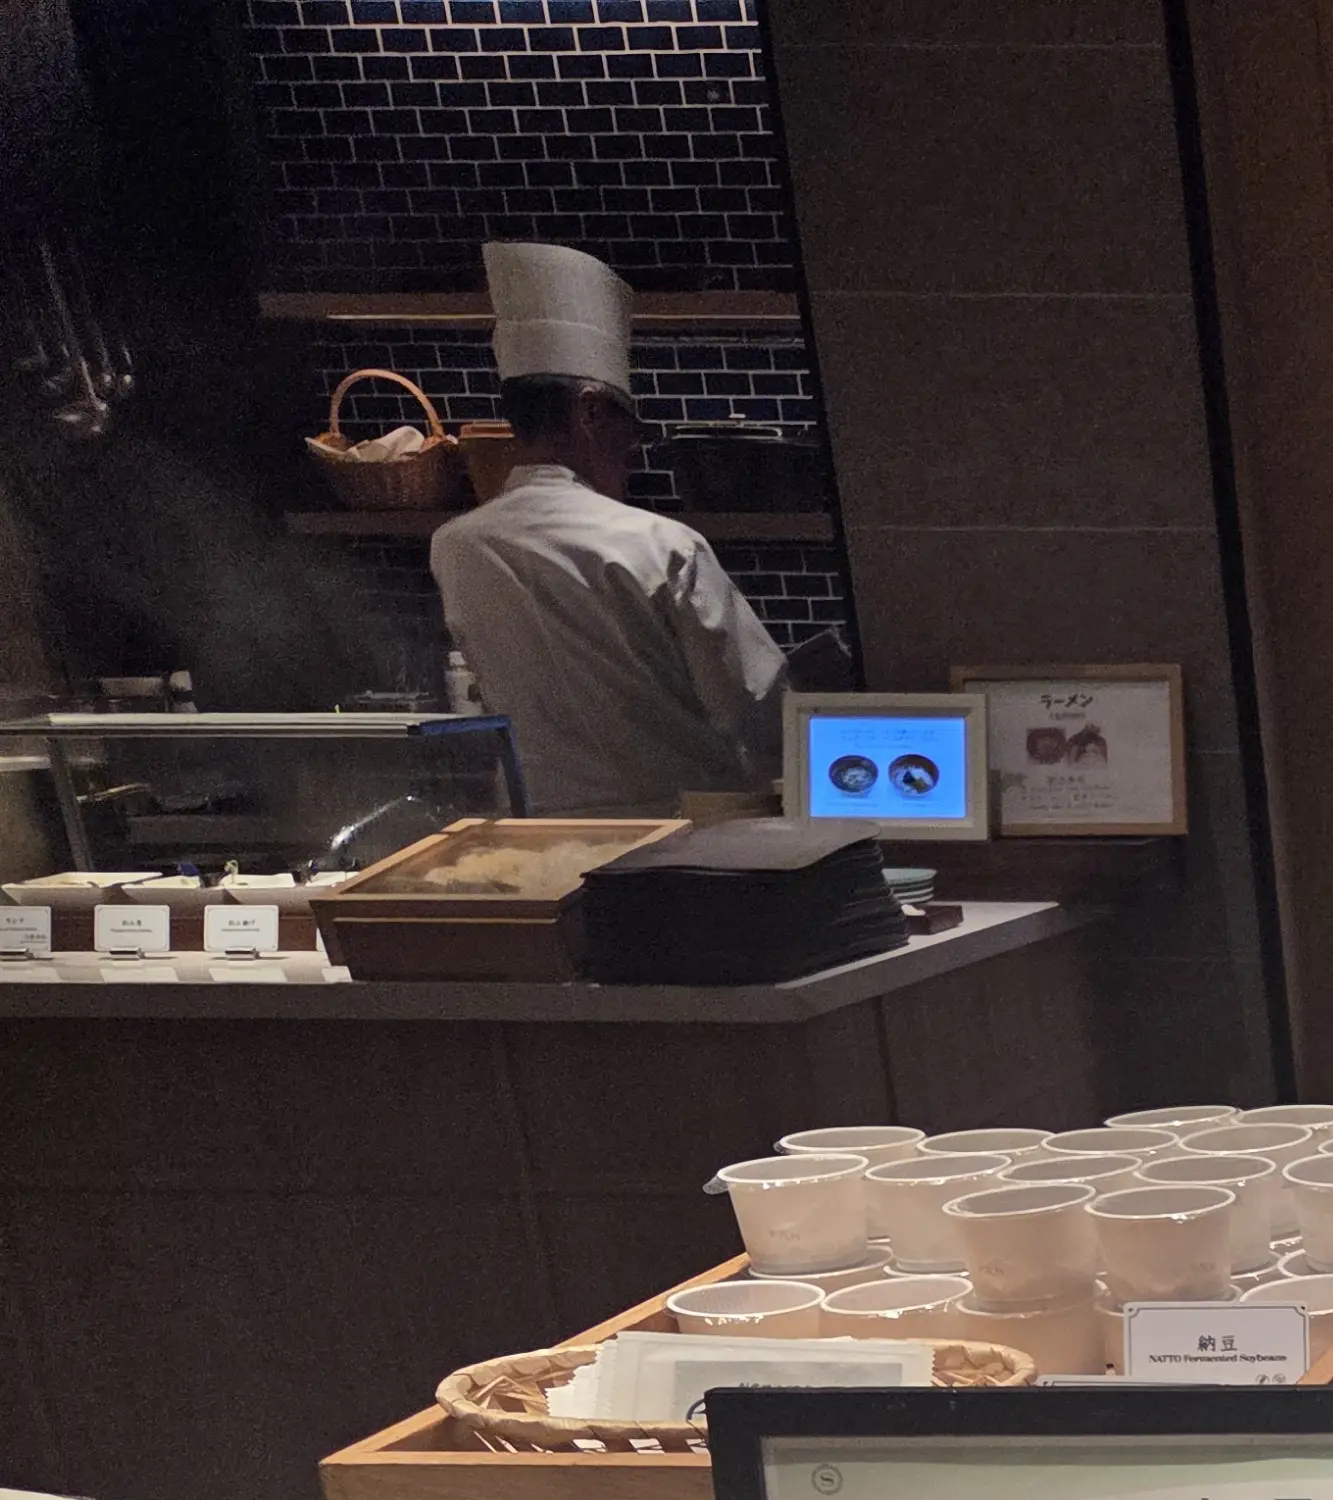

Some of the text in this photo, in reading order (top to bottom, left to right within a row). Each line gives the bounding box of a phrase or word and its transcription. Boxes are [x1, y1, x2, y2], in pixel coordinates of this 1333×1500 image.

[1197, 1335, 1238, 1352] 納豆
[1149, 1354, 1287, 1363] NATTO Fermented Soybeans
